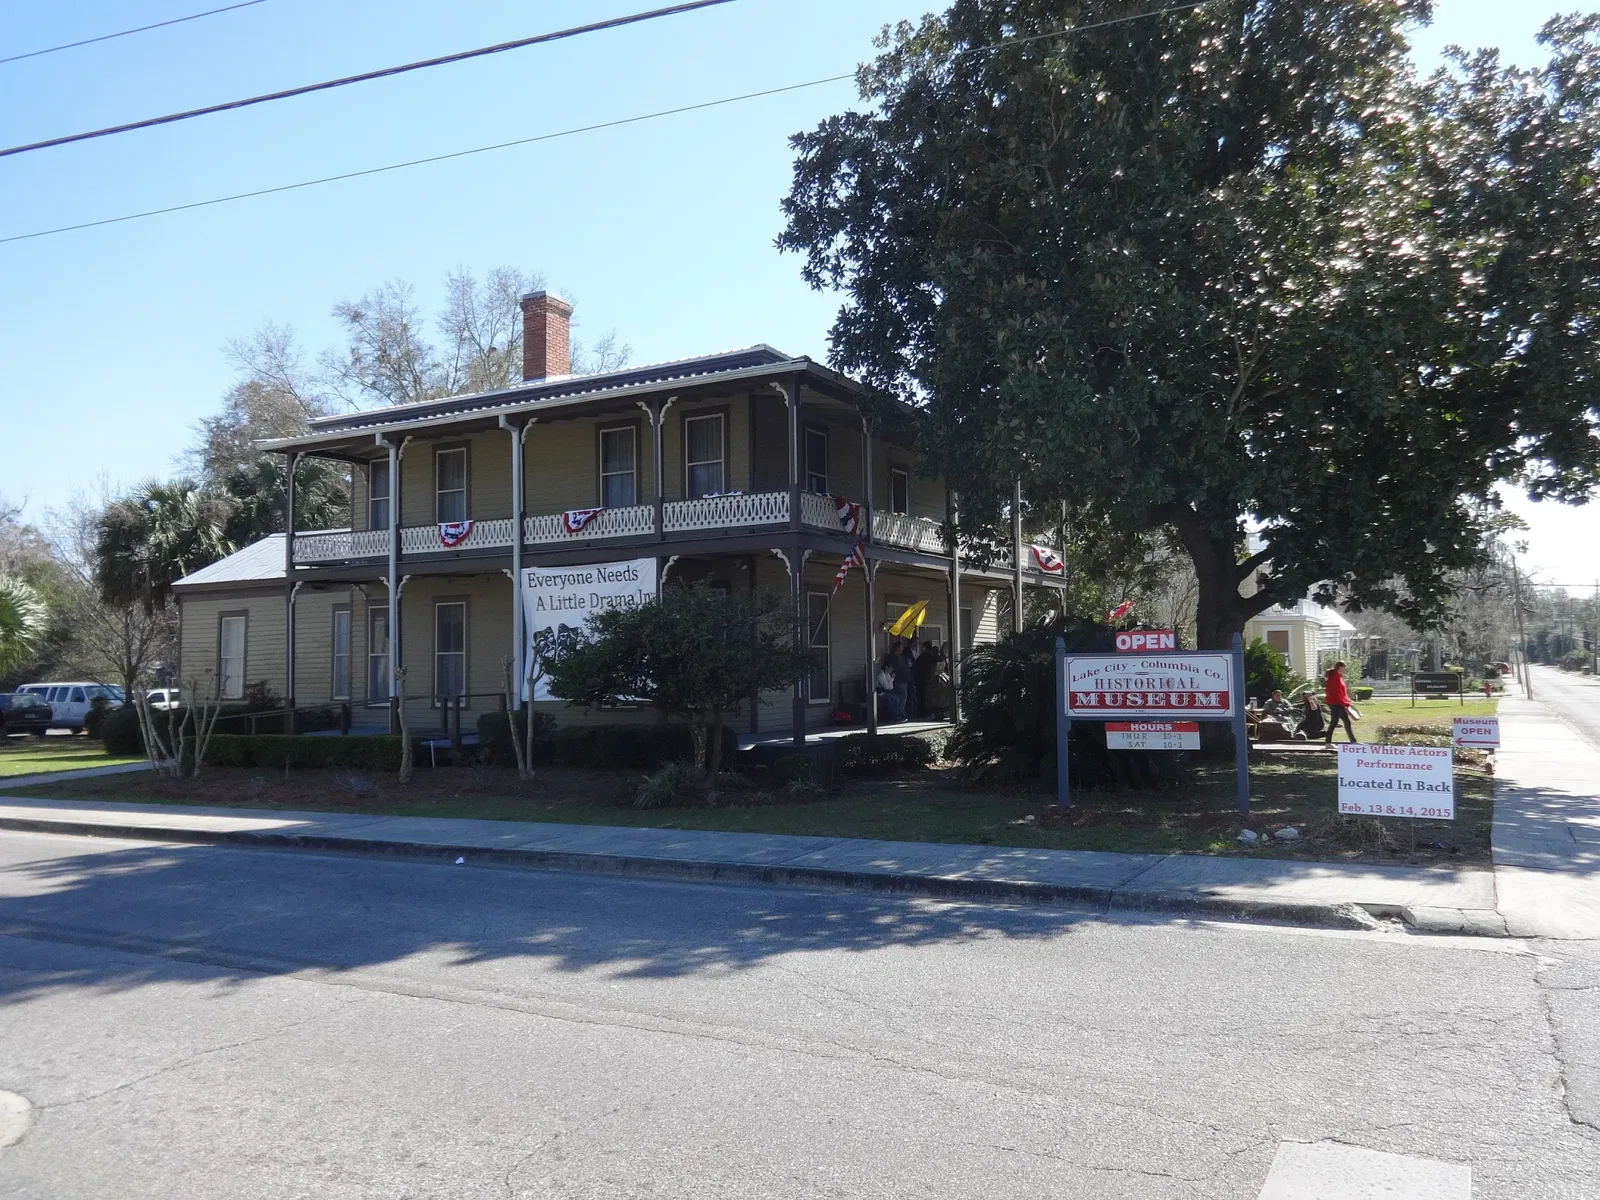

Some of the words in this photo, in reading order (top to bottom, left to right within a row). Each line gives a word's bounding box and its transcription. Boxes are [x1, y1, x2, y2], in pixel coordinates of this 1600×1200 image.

[528, 572, 593, 589] Everyone
[597, 565, 638, 583] Needs
[536, 596, 546, 611] A
[550, 594, 585, 610] Little
[589, 592, 635, 609] Drama
[1116, 634, 1174, 650] OPEN
[1073, 668, 1100, 683] Lake
[1105, 663, 1127, 673] City
[1141, 661, 1199, 673] Columbia
[1204, 668, 1224, 680] Co.
[1094, 677, 1200, 690] HISTORICAL
[1075, 693, 1221, 707] MUSEUM
[1342, 745, 1367, 753] Fort
[1371, 746, 1405, 755] White
[1408, 748, 1448, 757] Actors
[1356, 759, 1432, 770] Performance
[1339, 778, 1392, 789] Located
[1398, 780, 1412, 790] In
[1416, 781, 1450, 792] Back
[1341, 803, 1364, 812] Feb.
[1386, 806, 1395, 814] &
[1400, 807, 1417, 816] 14,
[1422, 808, 1450, 817] 2015
